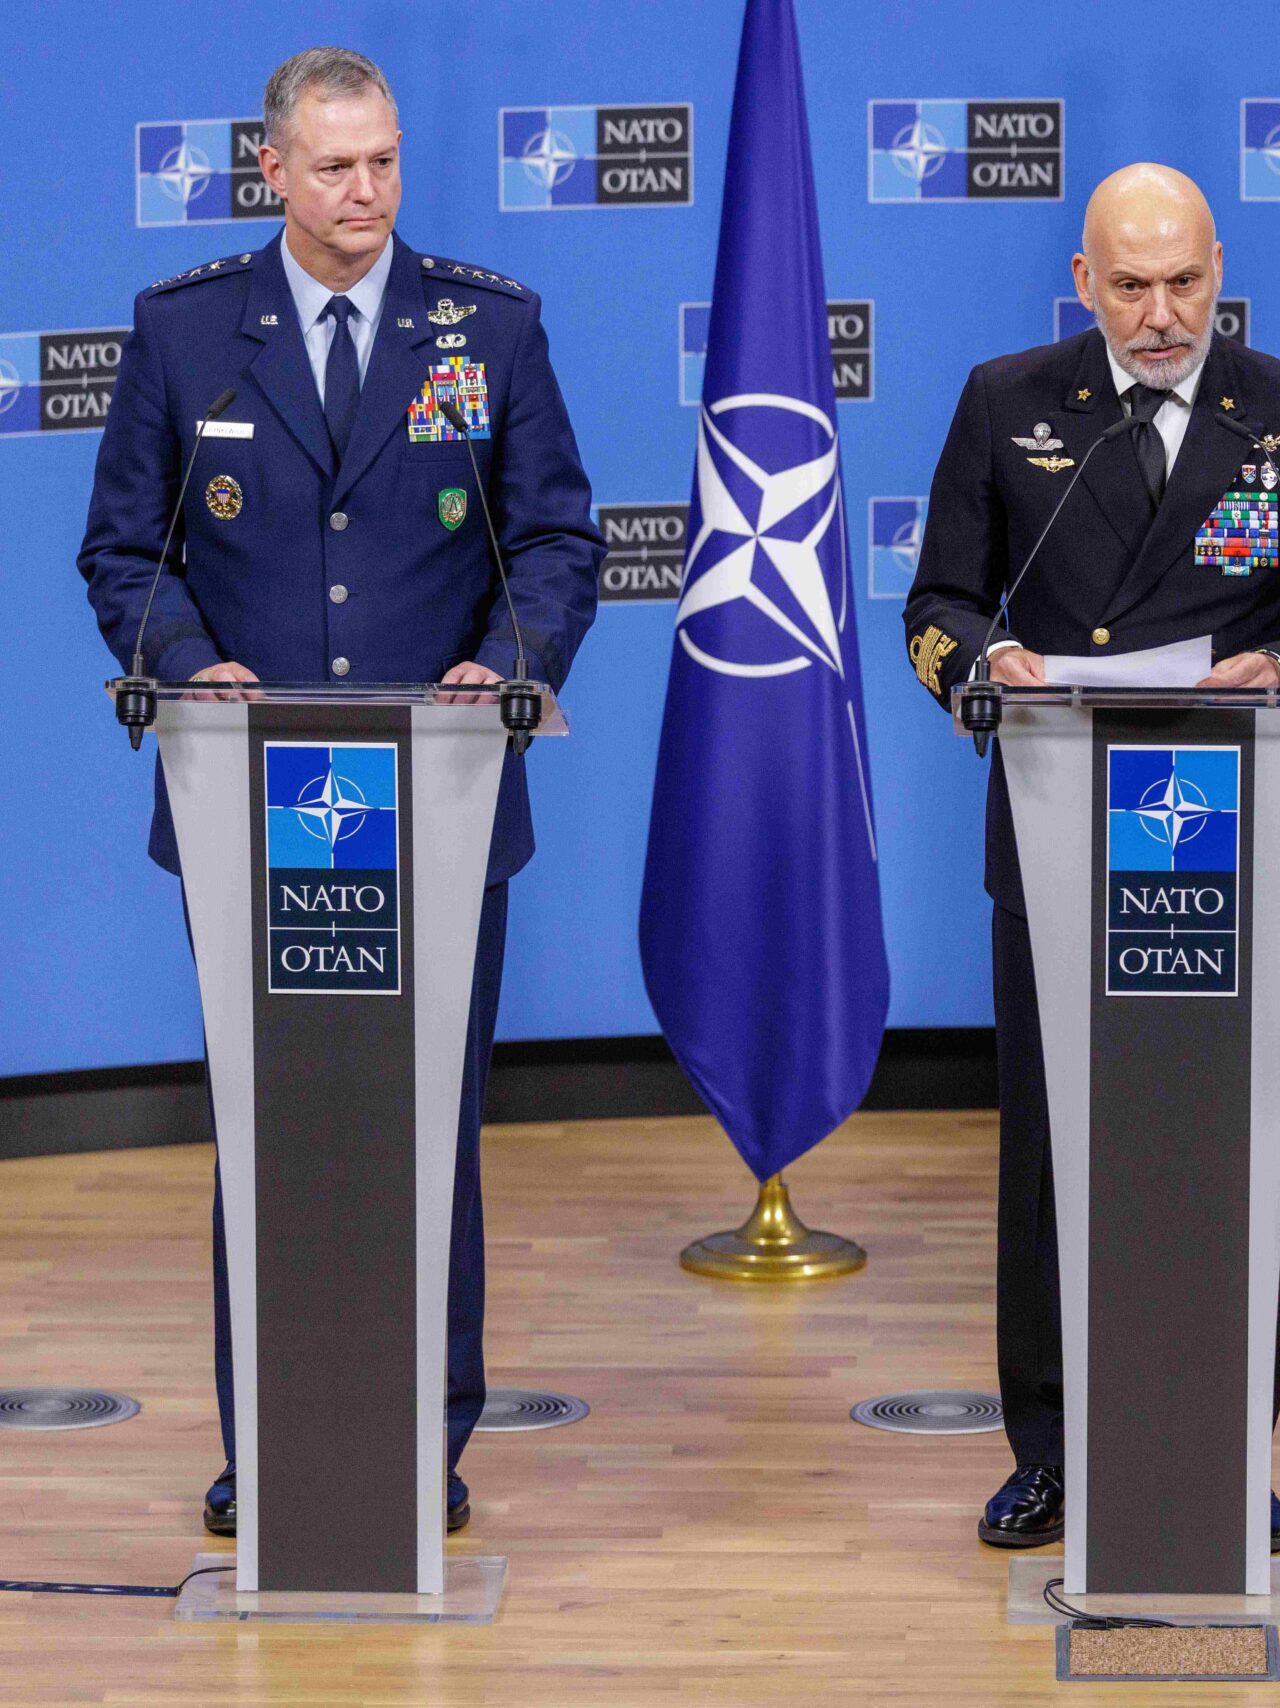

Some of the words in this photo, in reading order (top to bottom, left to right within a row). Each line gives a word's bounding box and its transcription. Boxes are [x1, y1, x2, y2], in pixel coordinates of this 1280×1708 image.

[603, 116, 683, 144] NATO
[974, 112, 1055, 139] NATO
[602, 166, 682, 194] OTAN
[972, 161, 1053, 188] OTAN
[237, 181, 281, 207] OT
[828, 314, 864, 340] TO
[47, 341, 122, 371] NATO
[605, 516, 684, 543] NATO
[603, 564, 683, 591] OTAN
[280, 884, 385, 913] NATO
[1119, 887, 1224, 915] NATO
[281, 945, 387, 973] OTAN
[1119, 947, 1225, 975] OTAN
